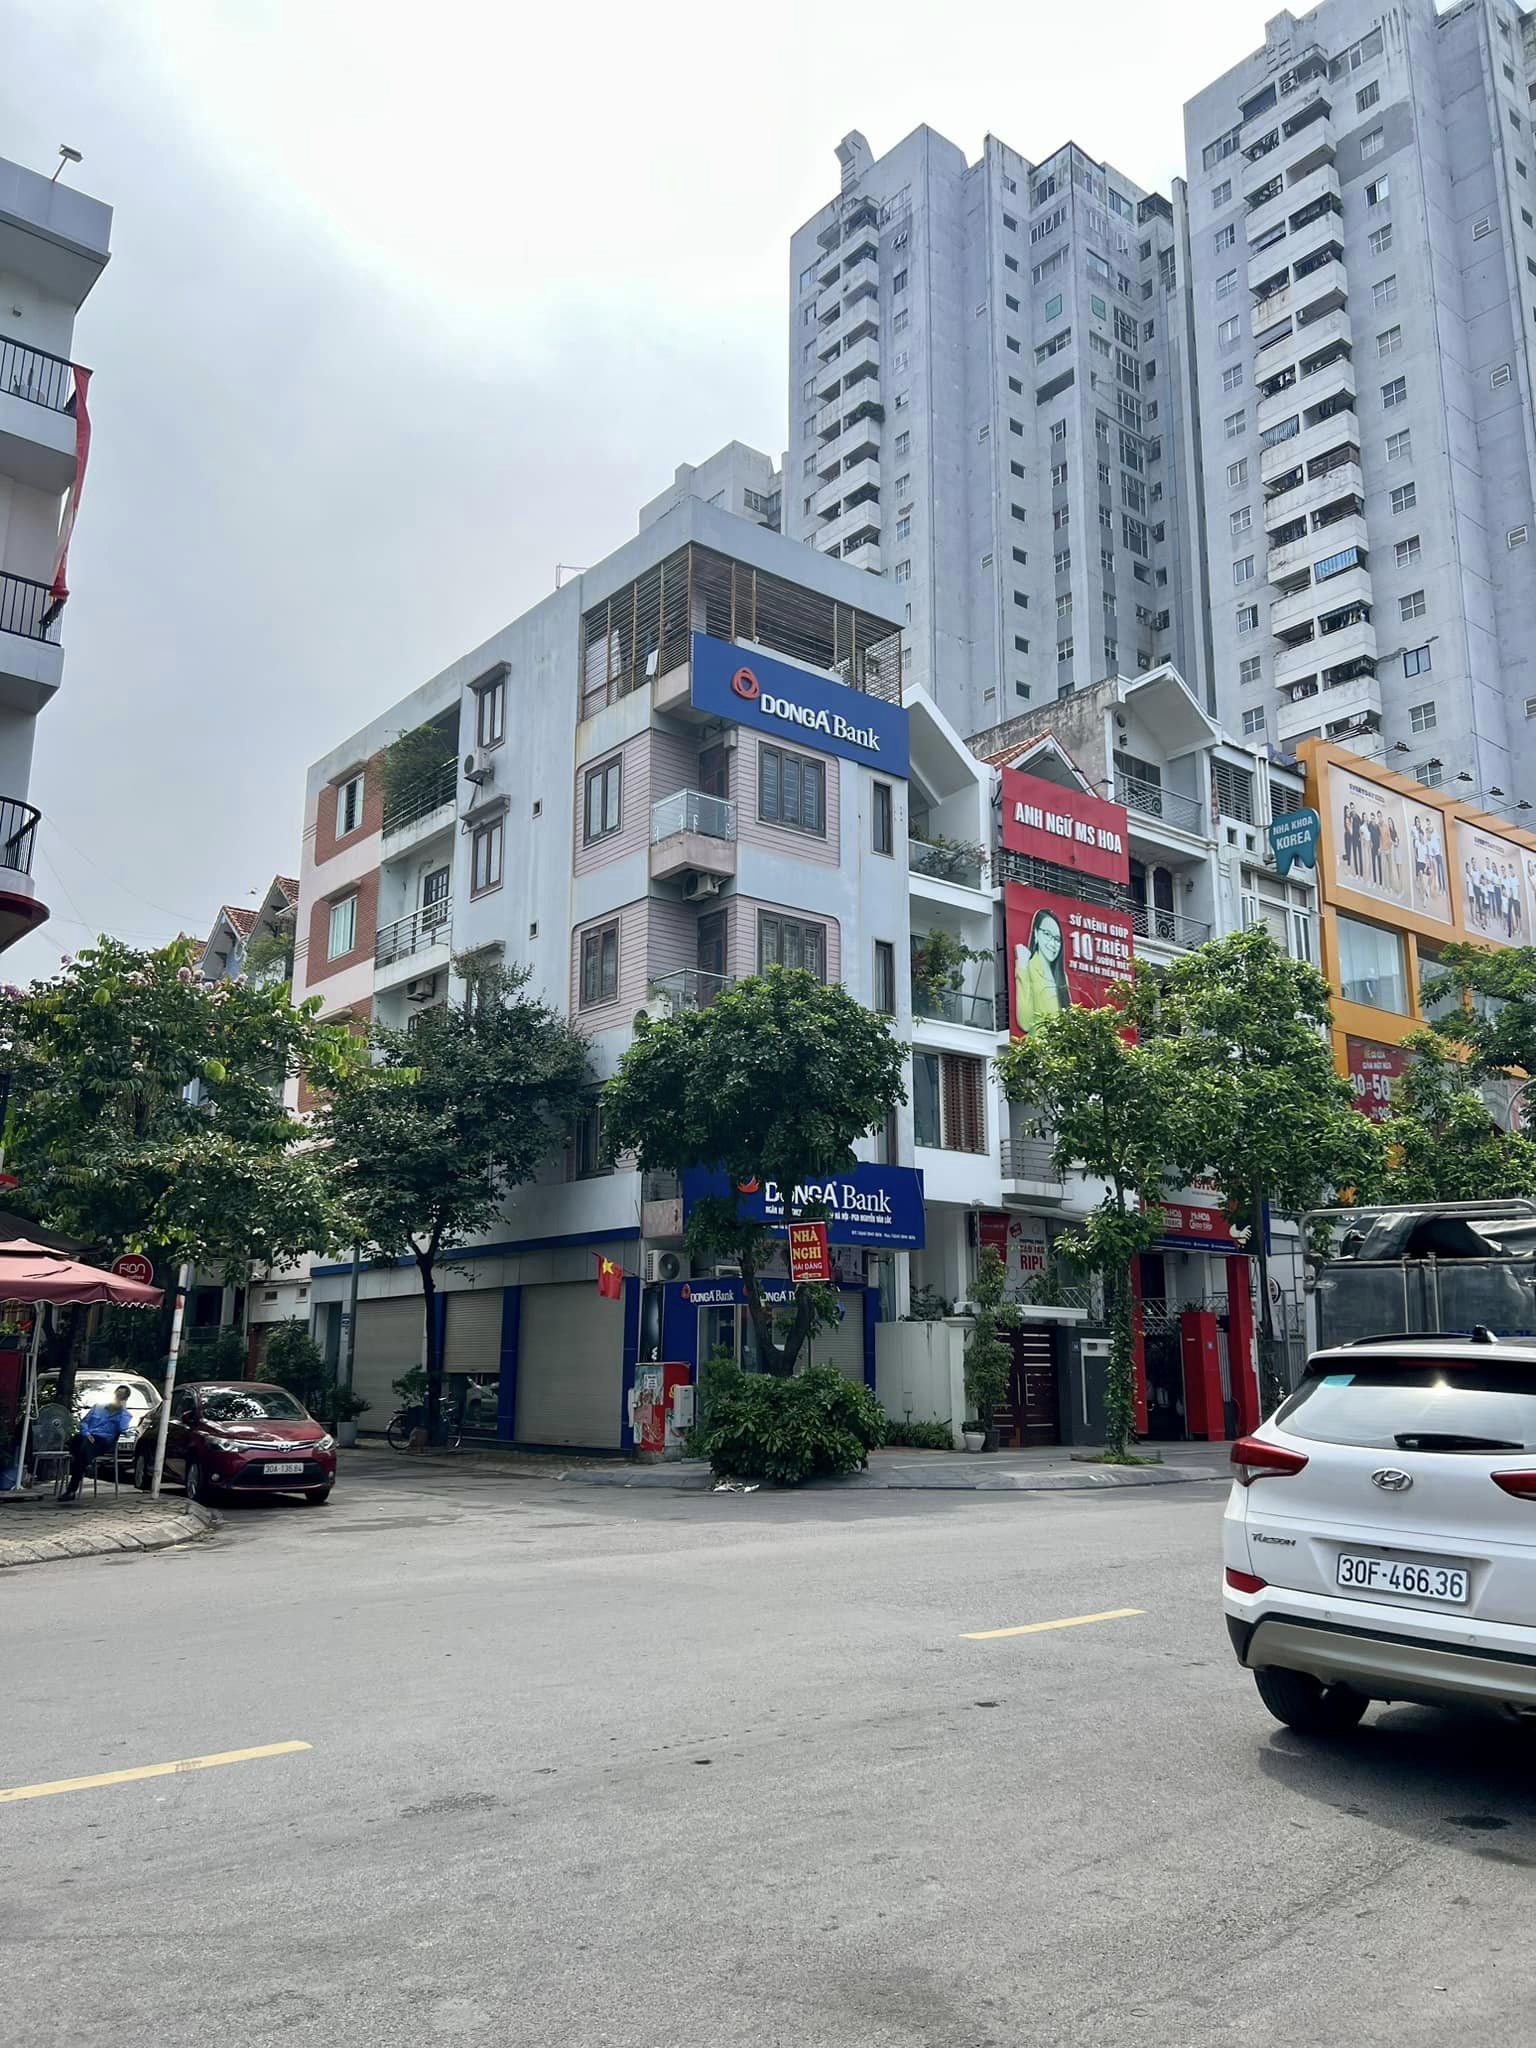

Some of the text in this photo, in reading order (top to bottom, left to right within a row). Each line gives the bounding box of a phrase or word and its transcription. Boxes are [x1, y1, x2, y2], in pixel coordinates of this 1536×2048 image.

[832, 714, 880, 750] Bank
[1014, 802, 1043, 829] ANH
[1074, 821, 1096, 846] MS
[1097, 828, 1122, 854] HOA
[1291, 816, 1313, 830] KHOA
[1276, 830, 1312, 850] KOREA
[1070, 931, 1129, 960] 10 TRIỆU
[842, 1184, 892, 1213] Bank
[716, 1290, 734, 1302] Bank
[1342, 1558, 1463, 1598] 30F-466.36
